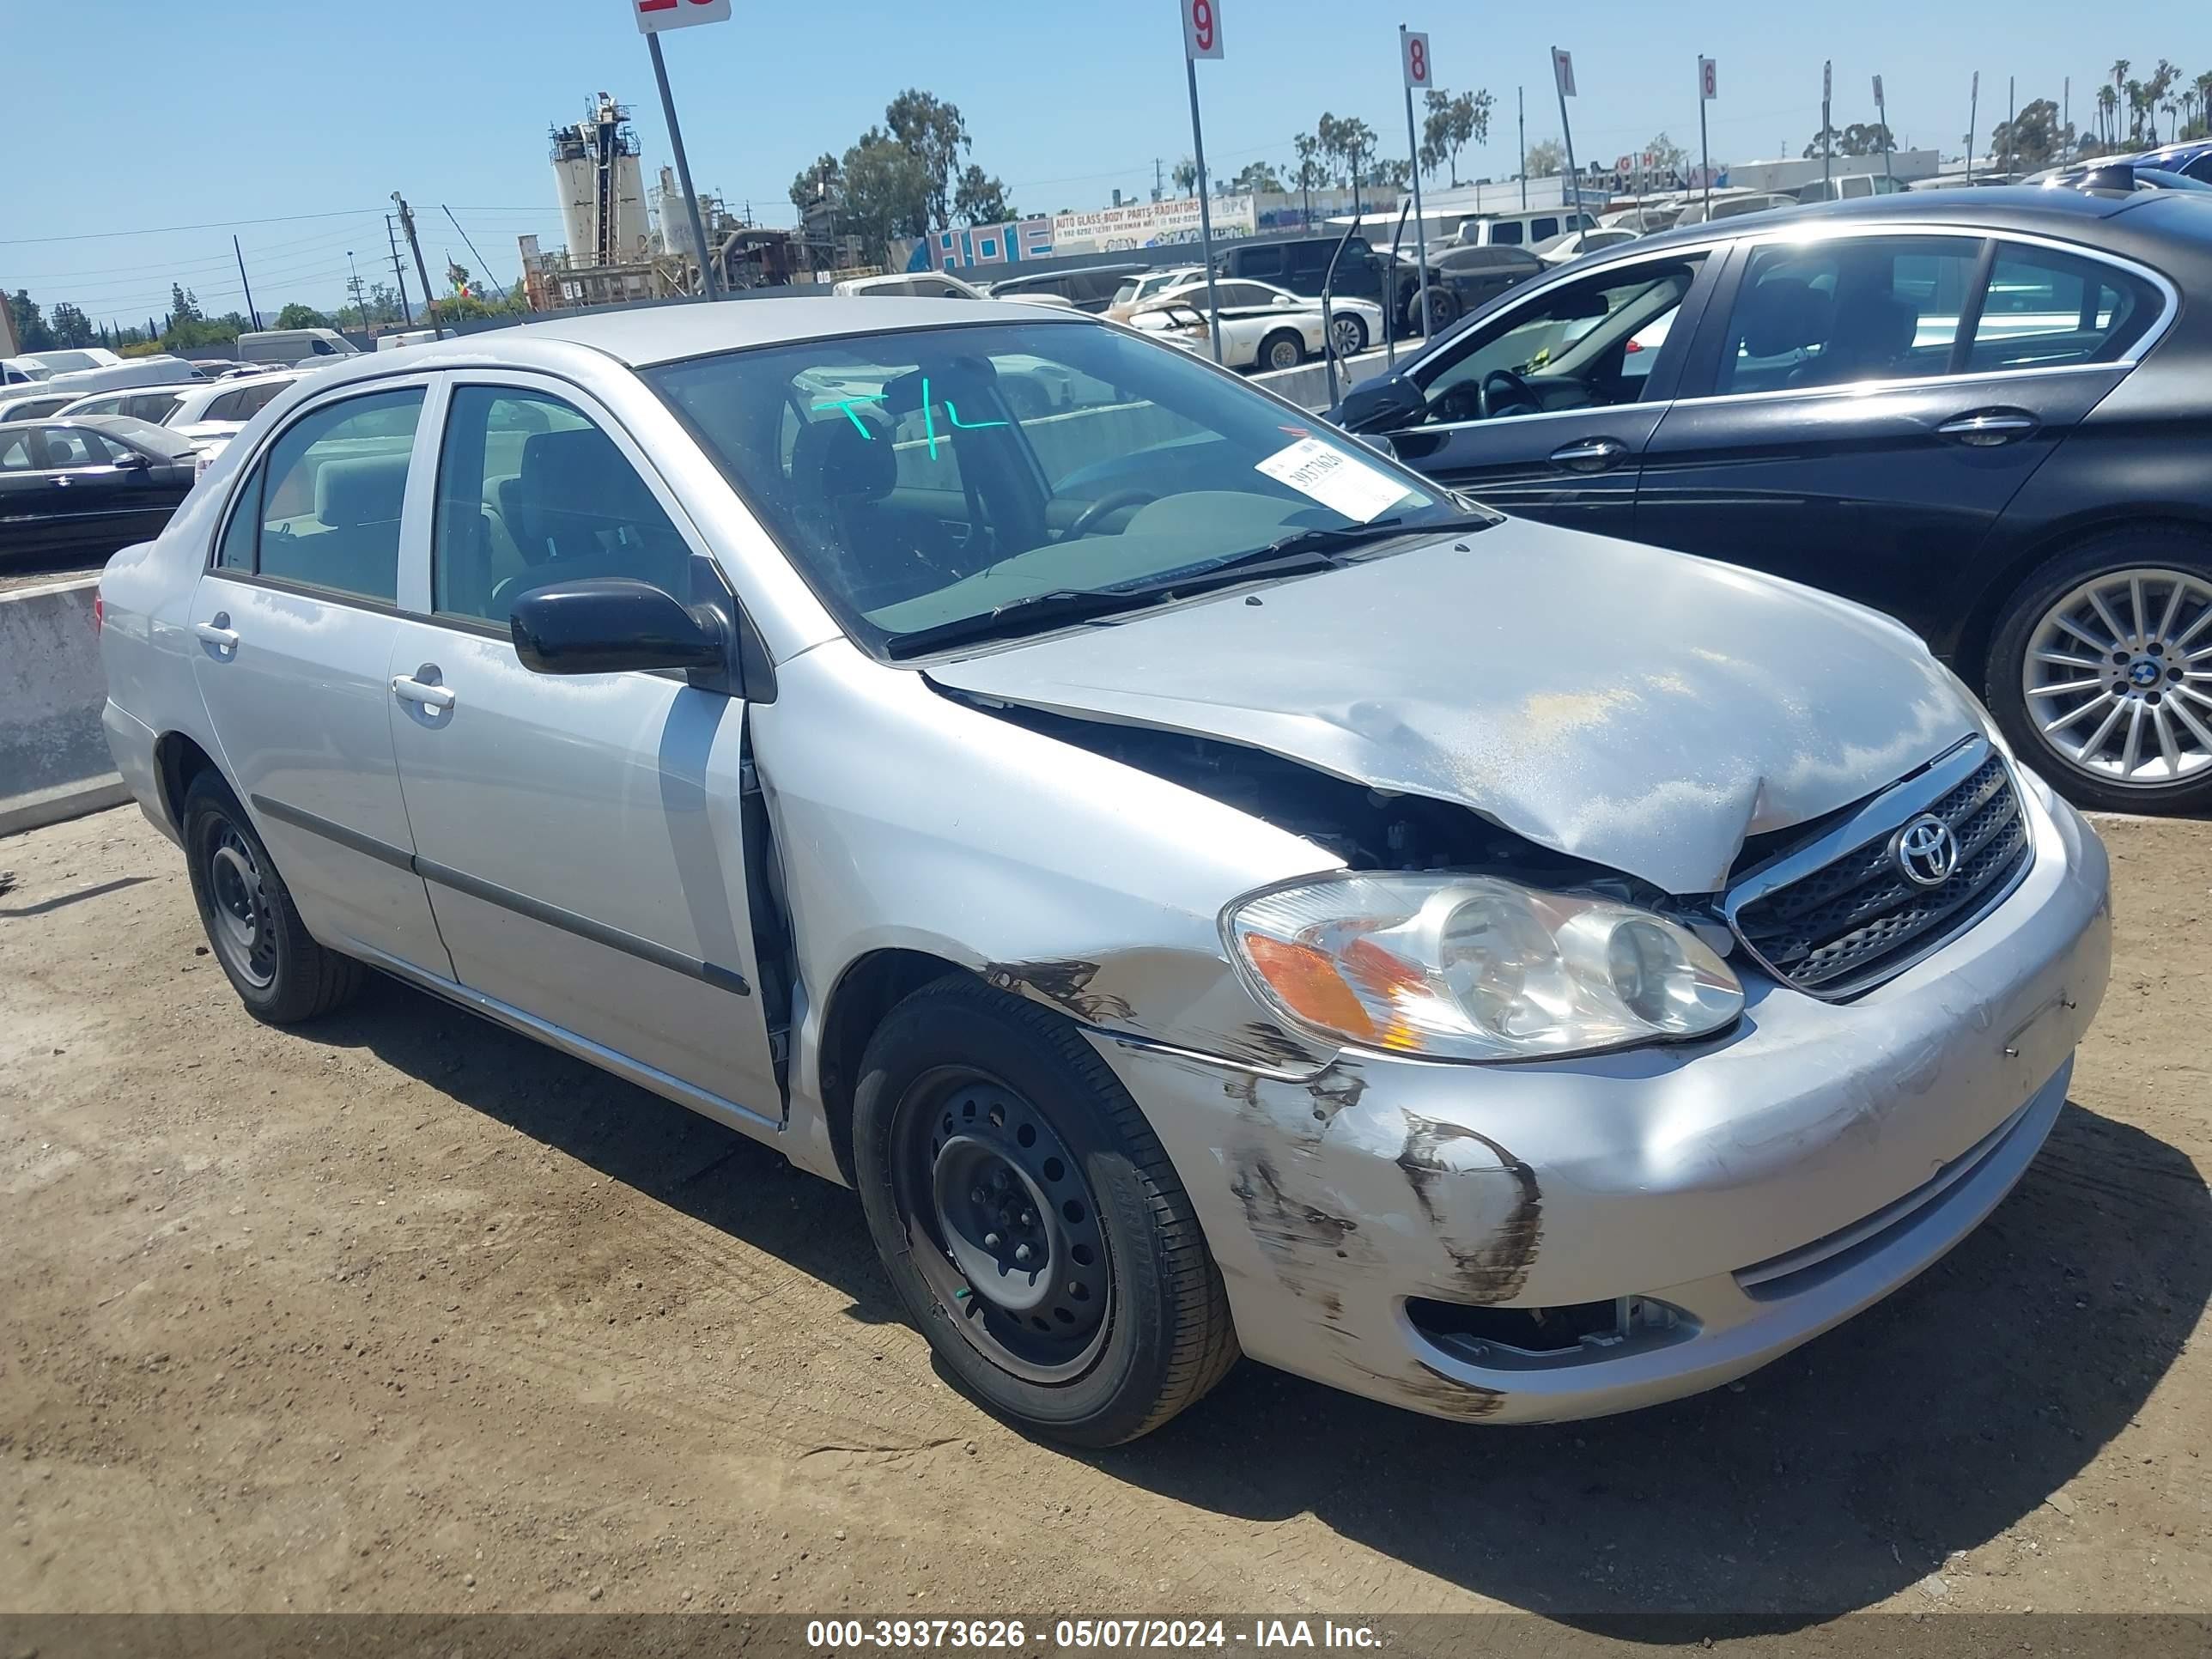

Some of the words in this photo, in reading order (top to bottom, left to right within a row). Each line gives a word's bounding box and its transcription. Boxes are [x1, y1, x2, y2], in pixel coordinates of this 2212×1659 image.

[1192, 0, 1213, 50] 9
[1410, 39, 1425, 81] 8
[1559, 56, 1569, 90] 7
[1705, 64, 1713, 94] 6
[1620, 157, 1630, 170] G
[1643, 153, 1652, 166] H
[1056, 216, 1075, 228] AUTO
[1289, 452, 1344, 487] 39373626
